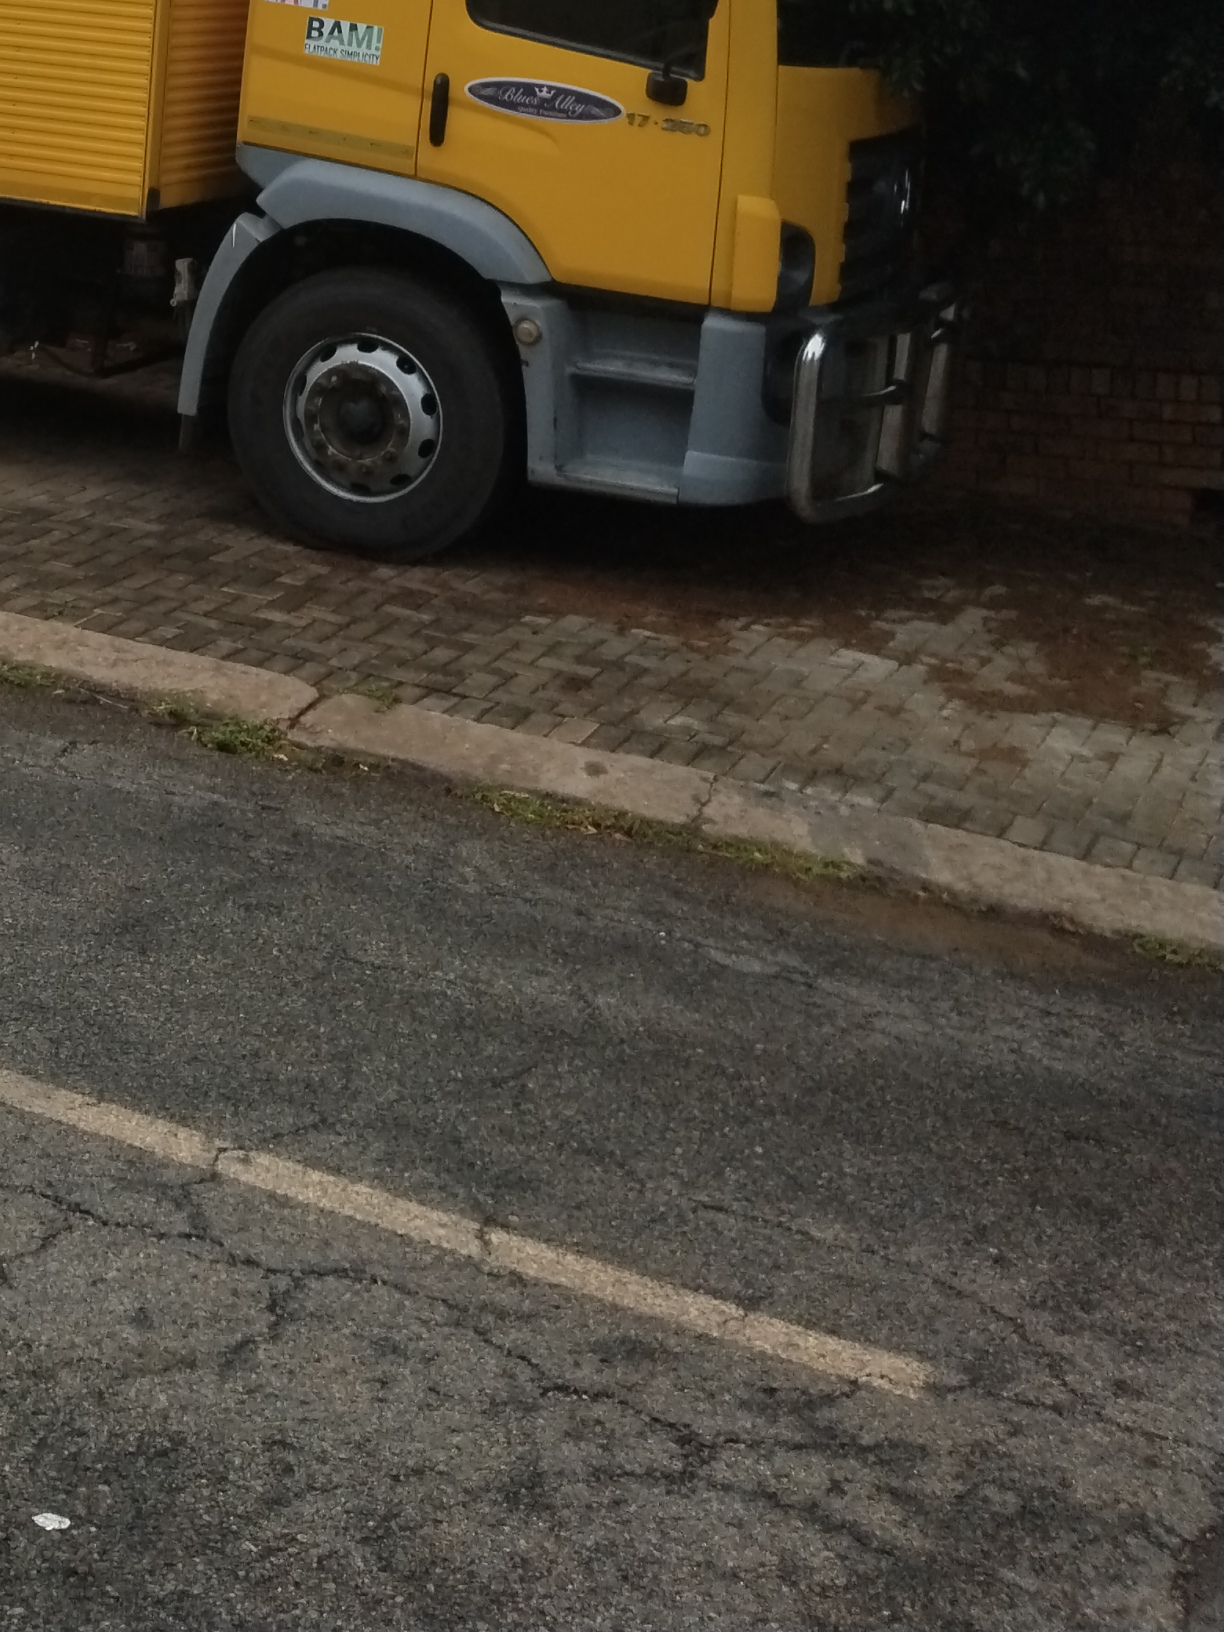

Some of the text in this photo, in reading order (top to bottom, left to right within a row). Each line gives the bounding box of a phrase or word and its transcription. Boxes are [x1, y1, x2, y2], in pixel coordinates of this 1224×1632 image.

[305, 15, 384, 52] BAM!
[304, 43, 380, 64] FLATPACK SIMPLICITY
[498, 86, 586, 118] Blues Alley
